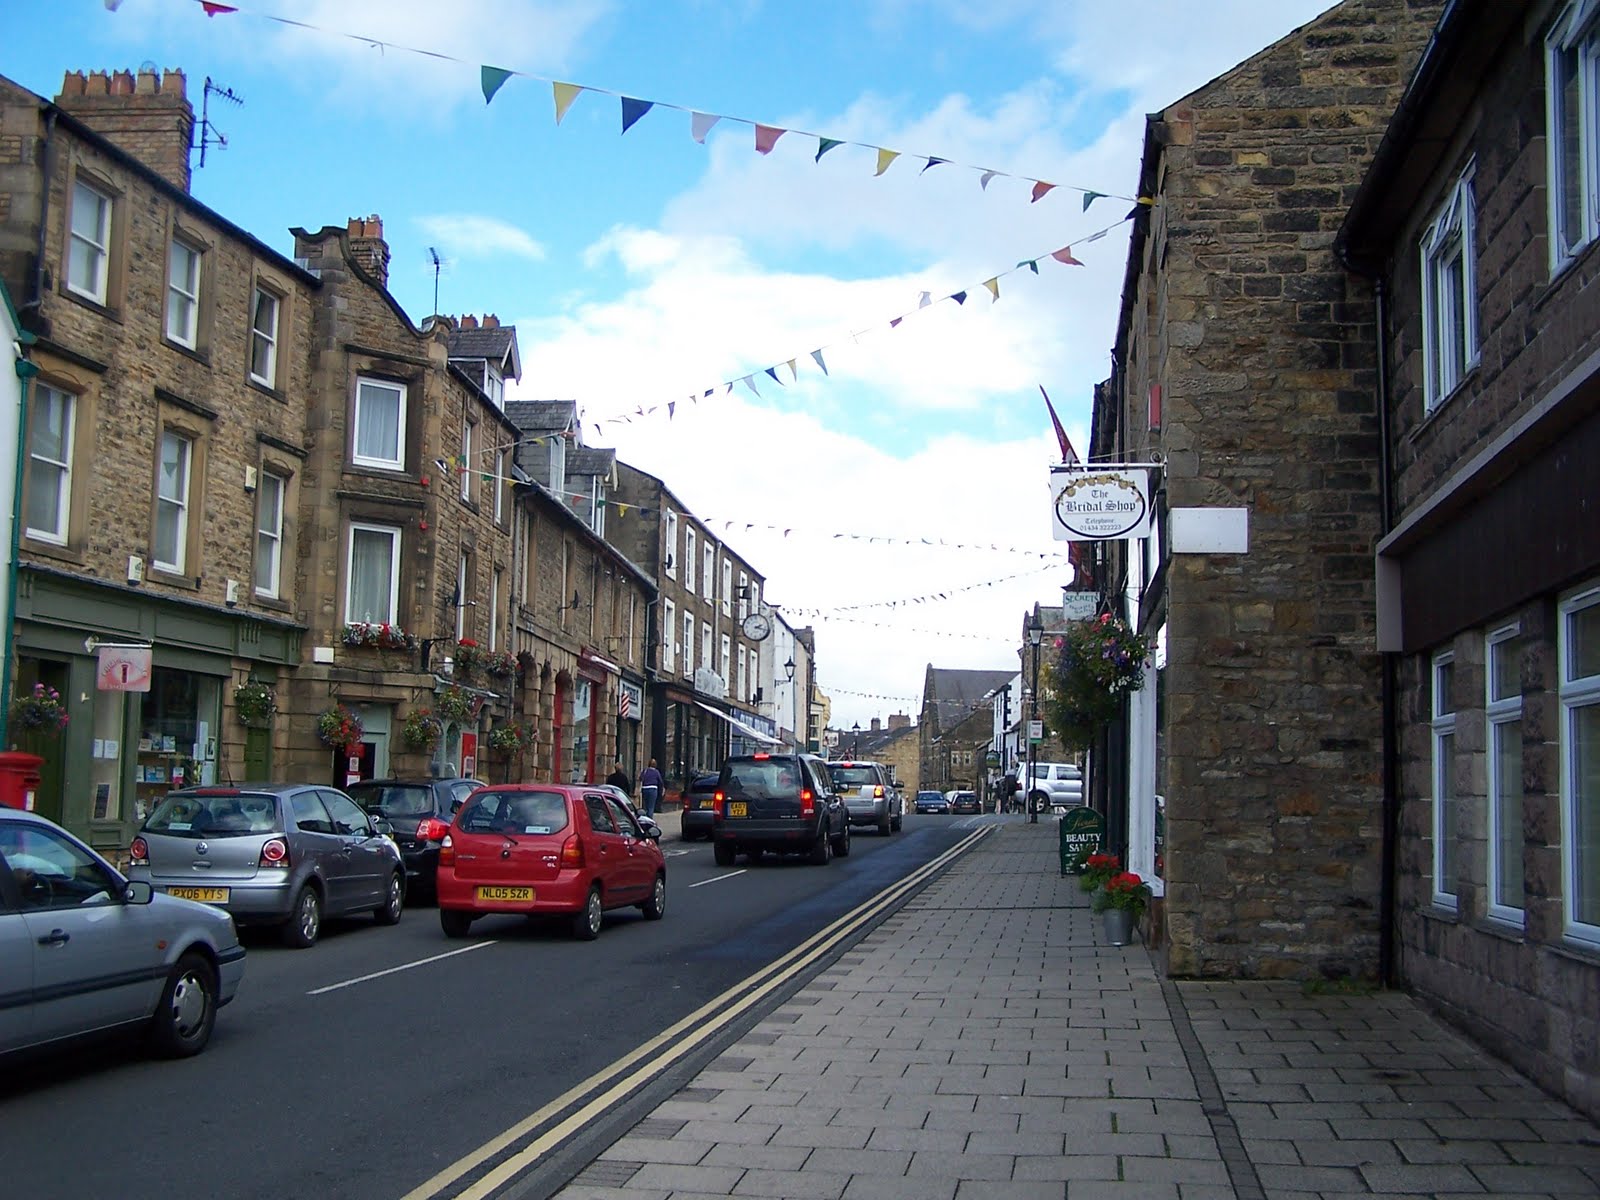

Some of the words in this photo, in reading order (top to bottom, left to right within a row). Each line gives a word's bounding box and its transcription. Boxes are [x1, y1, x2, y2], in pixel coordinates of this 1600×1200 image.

[1091, 489, 1109, 499] The
[1066, 501, 1102, 512] Bridal
[1105, 500, 1136, 512] Shop
[1066, 833, 1101, 842] BEAUTY
[173, 889, 200, 900] PX06
[203, 889, 223, 899] YTS
[482, 888, 508, 898] NL05
[510, 888, 529, 898] SZR
